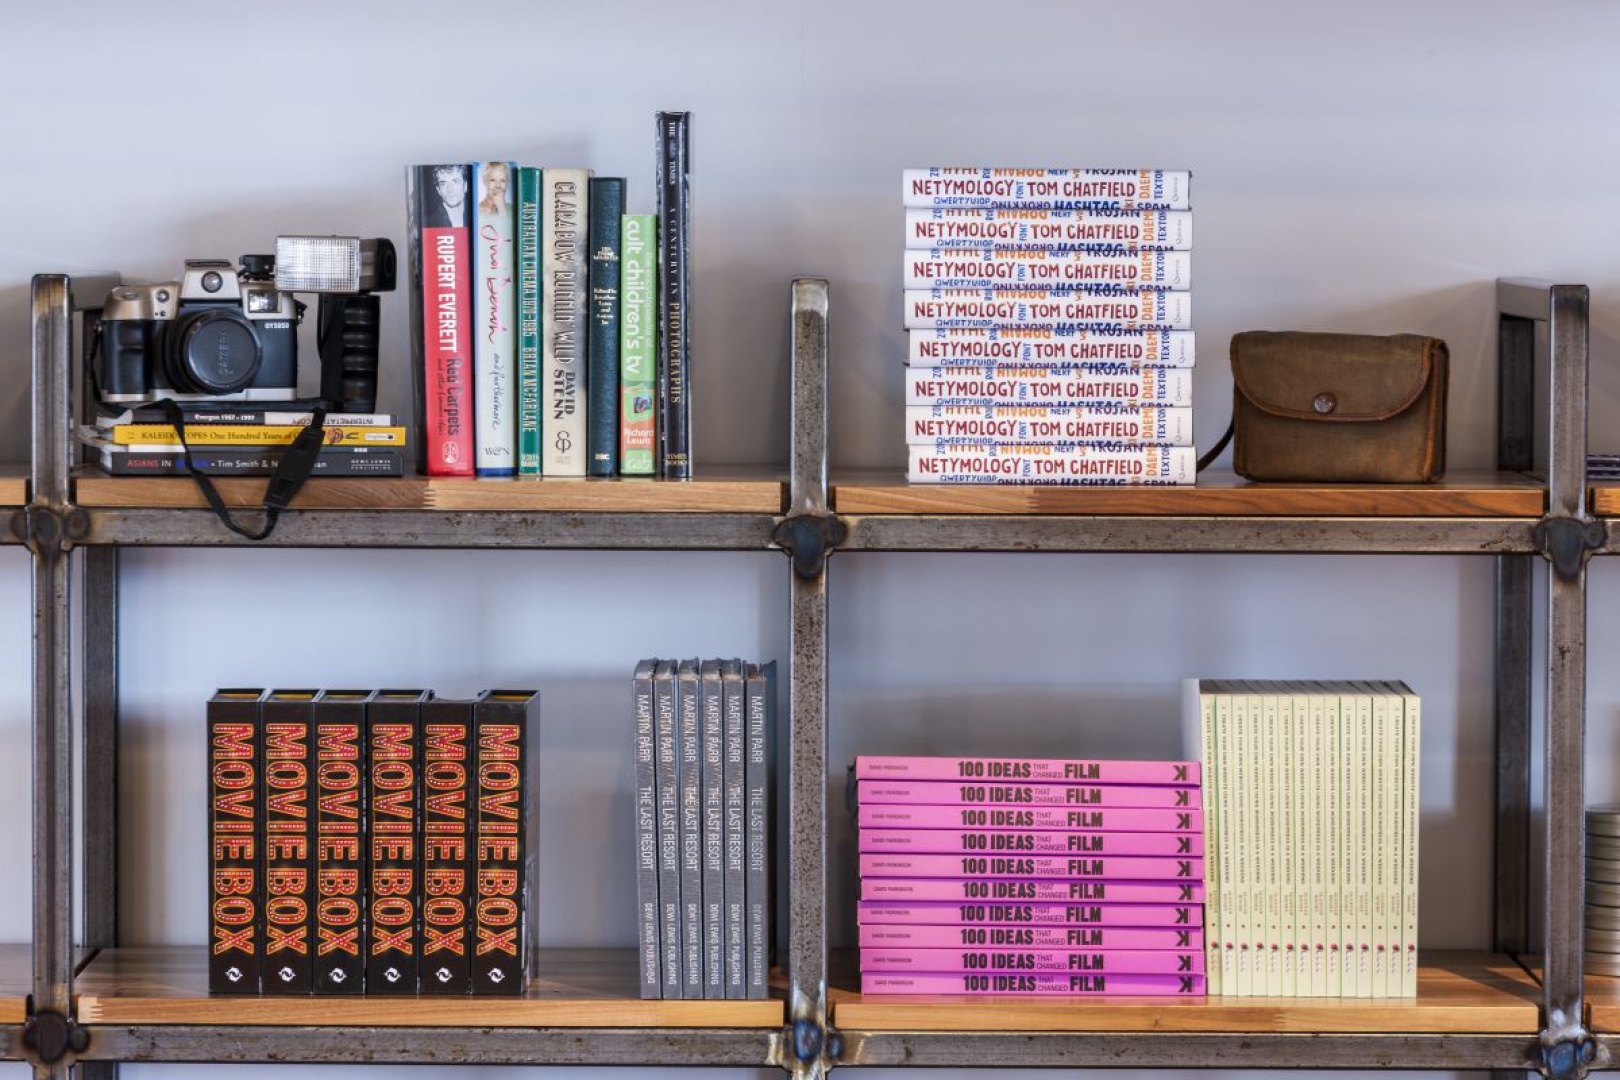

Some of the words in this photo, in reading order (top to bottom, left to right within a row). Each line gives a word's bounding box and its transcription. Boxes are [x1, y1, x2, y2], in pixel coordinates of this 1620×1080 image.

[914, 179, 1014, 196] NETYMOLOGY
[1028, 182, 1058, 196] TOM
[1064, 182, 1135, 197] CHATFIELD
[523, 202, 537, 258] AUSTRALIAN
[626, 220, 640, 256] cult
[916, 222, 1017, 239] NETYMOLOGY
[1031, 224, 1061, 239] TOM
[1068, 224, 1137, 240] CHATFIELD
[555, 229, 576, 263] BOW
[436, 236, 455, 289] RUPERT
[914, 262, 1013, 279] NETYMOLOGY
[1029, 264, 1060, 279] TOM
[1064, 264, 1137, 280] CHATFIELD
[523, 261, 537, 294] CINEMA
[670, 283, 678, 295] IN
[625, 260, 644, 349] children's
[915, 302, 1014, 321] NETYMOLOGY
[1031, 304, 1060, 317] TOM
[1066, 304, 1137, 318] CHATFIELD
[438, 294, 456, 352] EVERETT
[555, 332, 576, 364] WILD
[669, 302, 681, 404] PHOTOGRAPHS
[920, 342, 1019, 358] NETYMOLOGY
[1035, 343, 1066, 359] TOM
[1071, 344, 1143, 360] CHATFIELD
[447, 359, 462, 382] Red
[523, 347, 537, 375] BRIAN
[626, 356, 640, 374] tv
[554, 369, 564, 420] STENN
[565, 372, 575, 415] DAVID
[915, 381, 1015, 398] NETYMOLOGY
[1030, 383, 1061, 398] TOM
[1067, 380, 1138, 399] CHATFIELD
[444, 388, 462, 436] Carpets
[228, 432, 261, 440] Hundred
[915, 421, 1015, 437] NETYMOLOGY
[1030, 421, 1061, 437] TOM
[1066, 422, 1139, 438] CHATFIELD
[126, 460, 159, 468] ASIANS
[236, 460, 259, 468] Smith
[918, 457, 1019, 475] NETYMOLOGY
[1035, 459, 1065, 475] TOM
[1070, 459, 1143, 476] CHATFIELD
[660, 695, 674, 735] MARTIN
[706, 695, 719, 734] MARTIN
[729, 695, 741, 735] MARTIN
[751, 696, 762, 735] MARTIN
[660, 736, 674, 762] PARR
[707, 737, 719, 762] PARR
[729, 737, 741, 762] PARR
[752, 738, 762, 763] PARR
[960, 762, 982, 776] 100
[988, 763, 1030, 777] IDEAS
[1065, 764, 1099, 778] FILM
[213, 723, 254, 860] MOVIE
[266, 723, 307, 860] MOVIE
[318, 724, 359, 860] MOVIE
[372, 724, 413, 860] MOVIE
[425, 725, 466, 860] MOVIE
[478, 725, 519, 860] MOVIE
[662, 787, 674, 806] THE
[708, 787, 719, 805] THE
[729, 787, 741, 805] THE
[752, 788, 762, 806] THE
[961, 787, 984, 801] 100
[990, 787, 1032, 802] IDEAS
[1067, 789, 1100, 803] FILM
[663, 808, 674, 831] LAST
[708, 808, 719, 831] LAST
[729, 808, 741, 831] LAST
[752, 808, 762, 831] LAST
[962, 811, 985, 825] 100
[991, 812, 1033, 826] IDEAS
[1068, 813, 1102, 826] FILM
[664, 834, 676, 871] RESORT
[708, 834, 720, 871] RESORT
[729, 834, 741, 871] RESORT
[752, 835, 763, 871] RESORT
[962, 834, 985, 849] 100
[991, 835, 1034, 850] IDEAS
[1068, 836, 1102, 850] FILM
[962, 859, 985, 873] 100
[991, 859, 1034, 874] IDEAS
[1068, 860, 1103, 875] FILM
[964, 882, 988, 897] 100
[993, 883, 1035, 898] IDEAS
[1070, 884, 1104, 898] FILM
[213, 868, 254, 954] BOX
[266, 868, 307, 954] BOX
[318, 868, 358, 955] BOX
[372, 868, 413, 955] BOX
[424, 869, 465, 955] BOX
[476, 868, 517, 955] BOX
[960, 905, 983, 921] 100
[990, 906, 1032, 921] IDEAS
[1067, 907, 1101, 922] FILM
[962, 929, 985, 944] 100
[991, 929, 1033, 944] IDEAS
[1068, 930, 1102, 945] FILM
[963, 953, 986, 968] 100
[992, 954, 1034, 969] IDEAS
[1069, 955, 1103, 969] FILM
[964, 975, 988, 990] 100
[993, 976, 1036, 991] IDEAS
[1070, 977, 1105, 991] FILM
